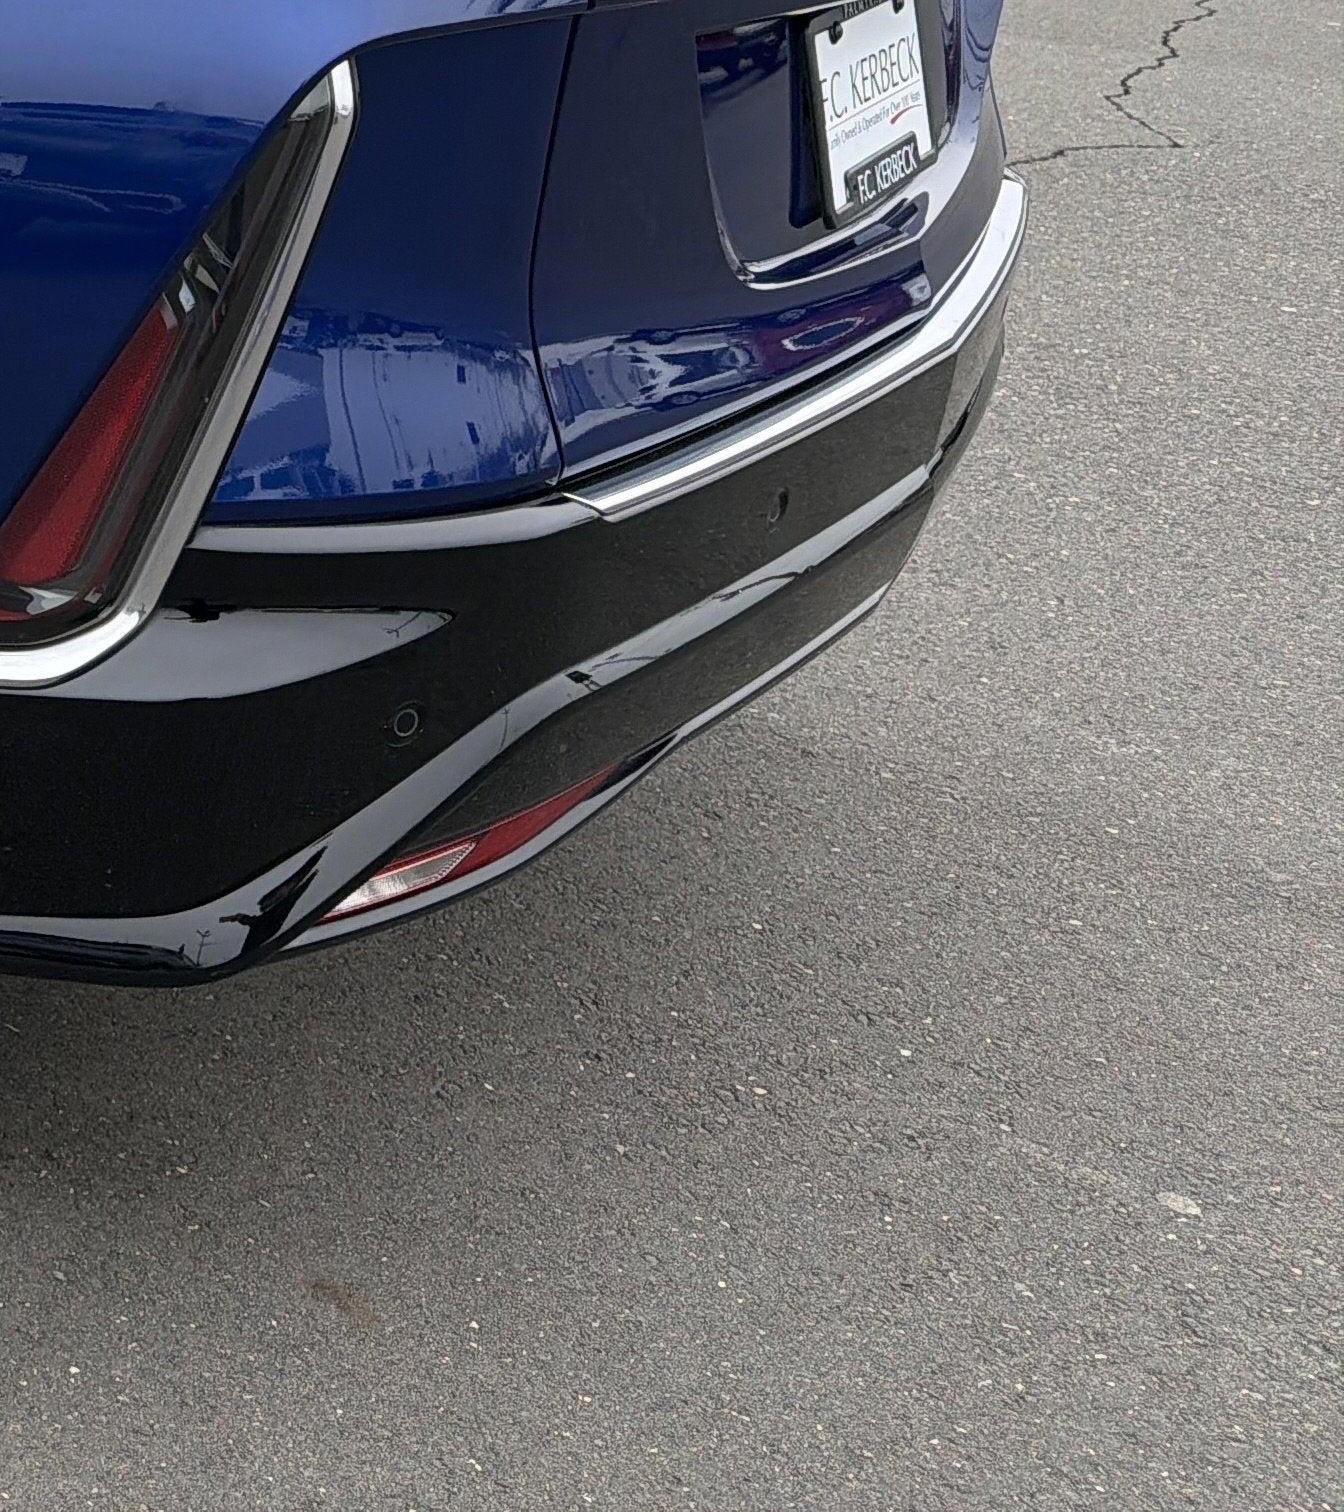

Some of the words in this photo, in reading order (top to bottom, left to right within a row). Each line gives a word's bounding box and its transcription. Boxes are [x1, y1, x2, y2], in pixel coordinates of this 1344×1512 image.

[849, 33, 921, 109] KERBECK
[857, 171, 876, 204] F.C.
[875, 142, 918, 194] KERBECK
